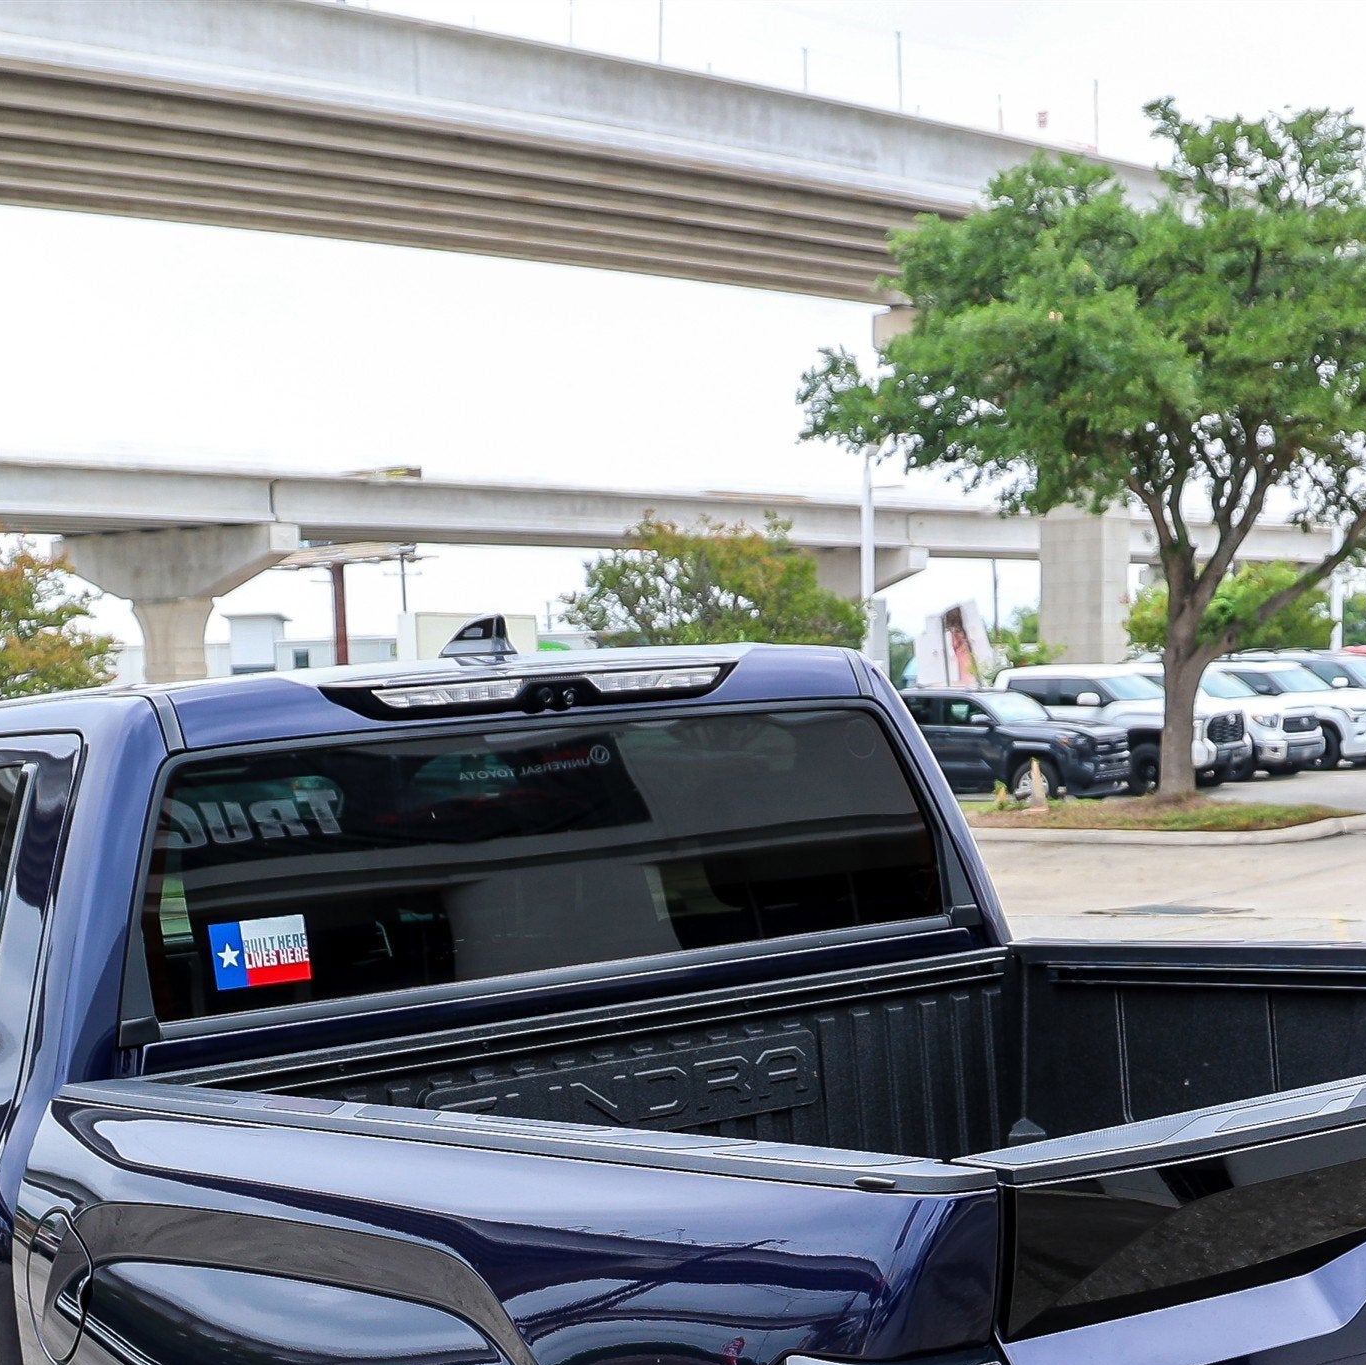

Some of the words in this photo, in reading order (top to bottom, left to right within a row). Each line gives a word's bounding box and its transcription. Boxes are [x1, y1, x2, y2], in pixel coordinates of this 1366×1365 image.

[243, 936, 276, 954] BUILT
[277, 932, 308, 951] HERE
[244, 950, 278, 970] LIVES
[279, 947, 310, 965] HERE
